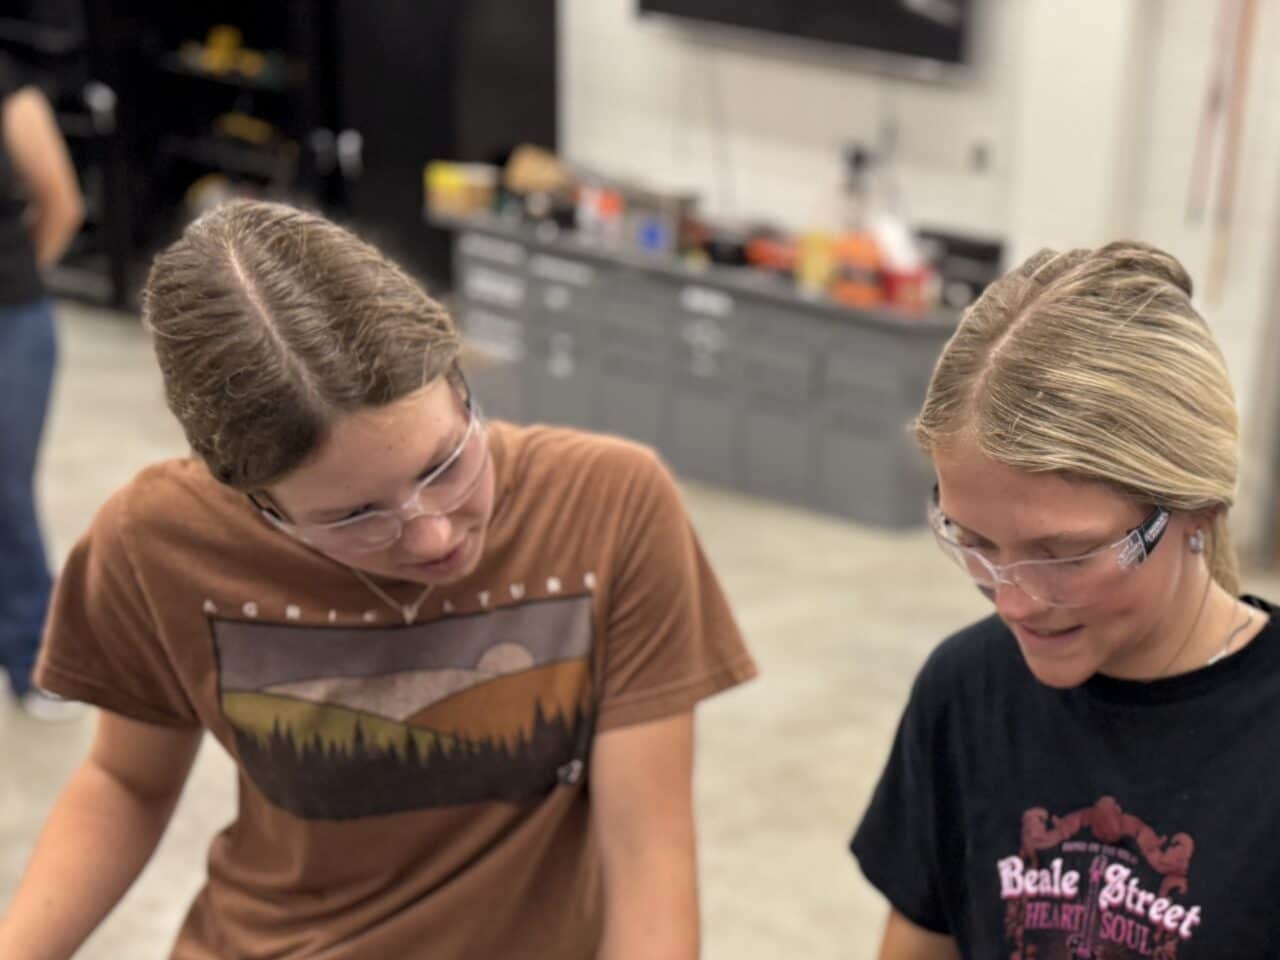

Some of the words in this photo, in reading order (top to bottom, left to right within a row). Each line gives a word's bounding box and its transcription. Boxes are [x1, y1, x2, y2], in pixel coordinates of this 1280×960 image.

[998, 855, 1080, 898] Beale
[1099, 863, 1202, 938] Street
[1024, 903, 1084, 932] HEART
[1101, 911, 1150, 955] SOUL
